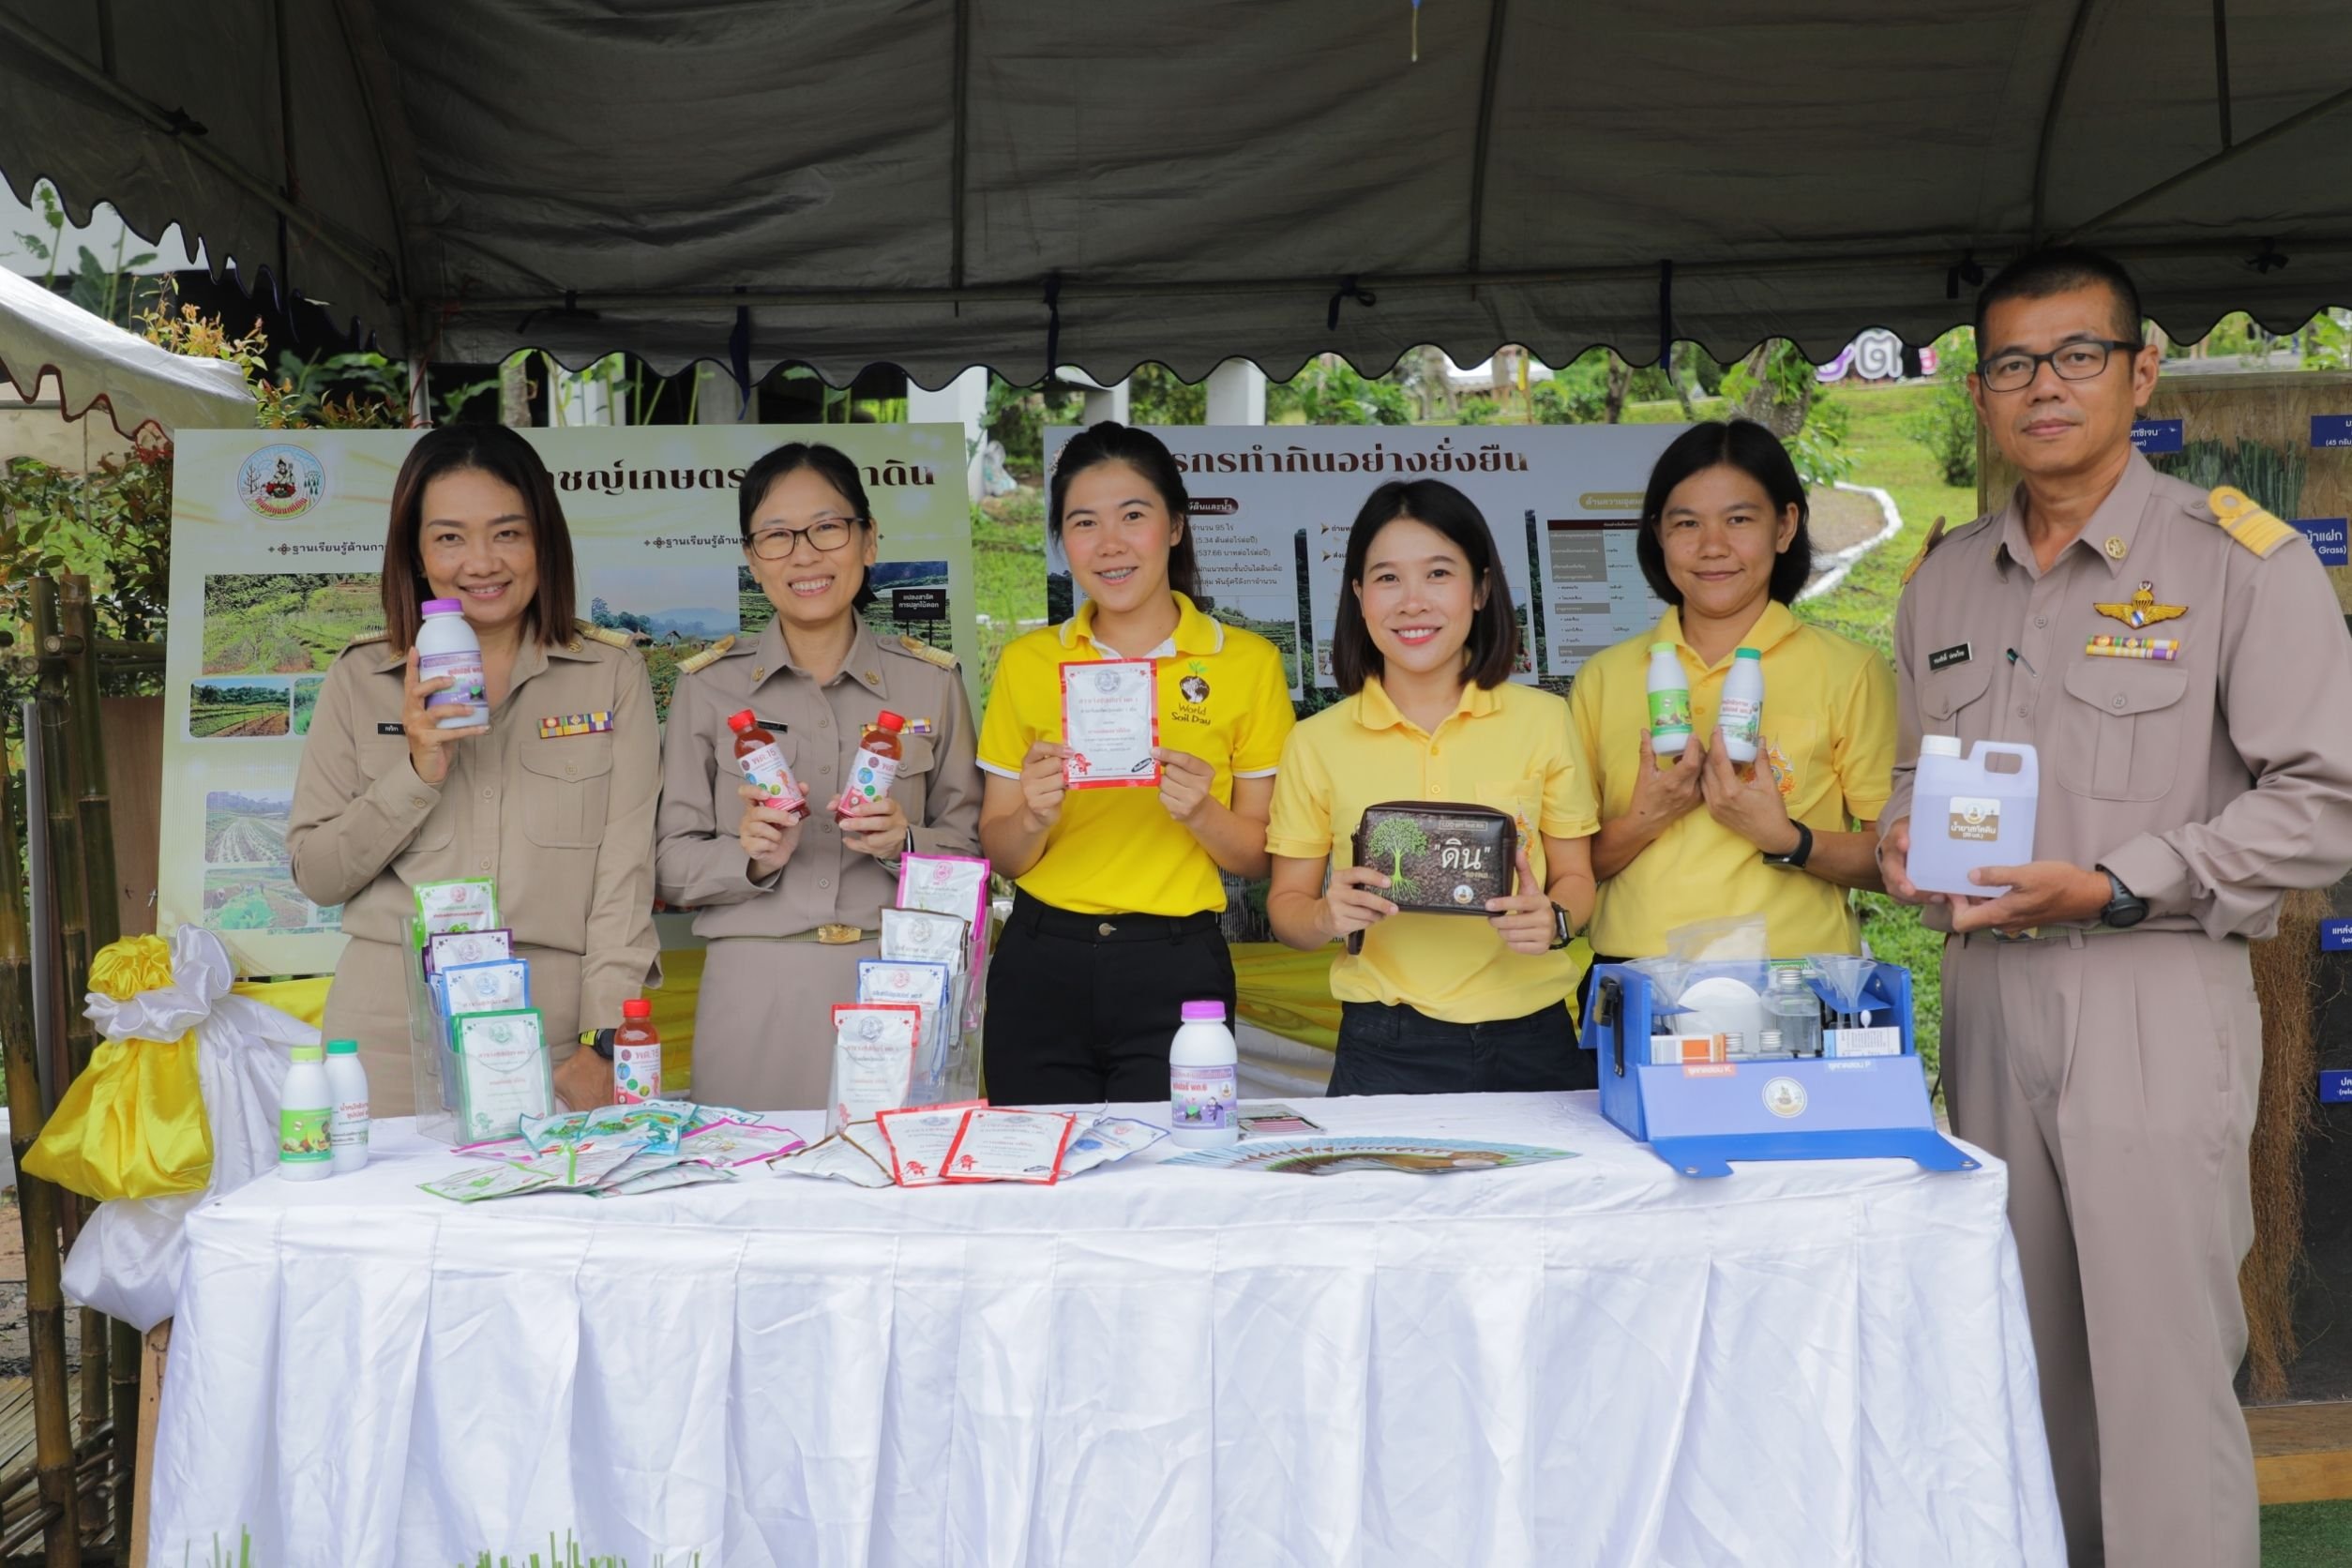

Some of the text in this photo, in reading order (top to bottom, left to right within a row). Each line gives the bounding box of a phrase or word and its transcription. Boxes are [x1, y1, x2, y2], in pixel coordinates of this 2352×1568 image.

[2318, 545, 2347, 555] Grass)
[1179, 703, 1207, 716] World
[1171, 712, 1211, 726] Soil Day
